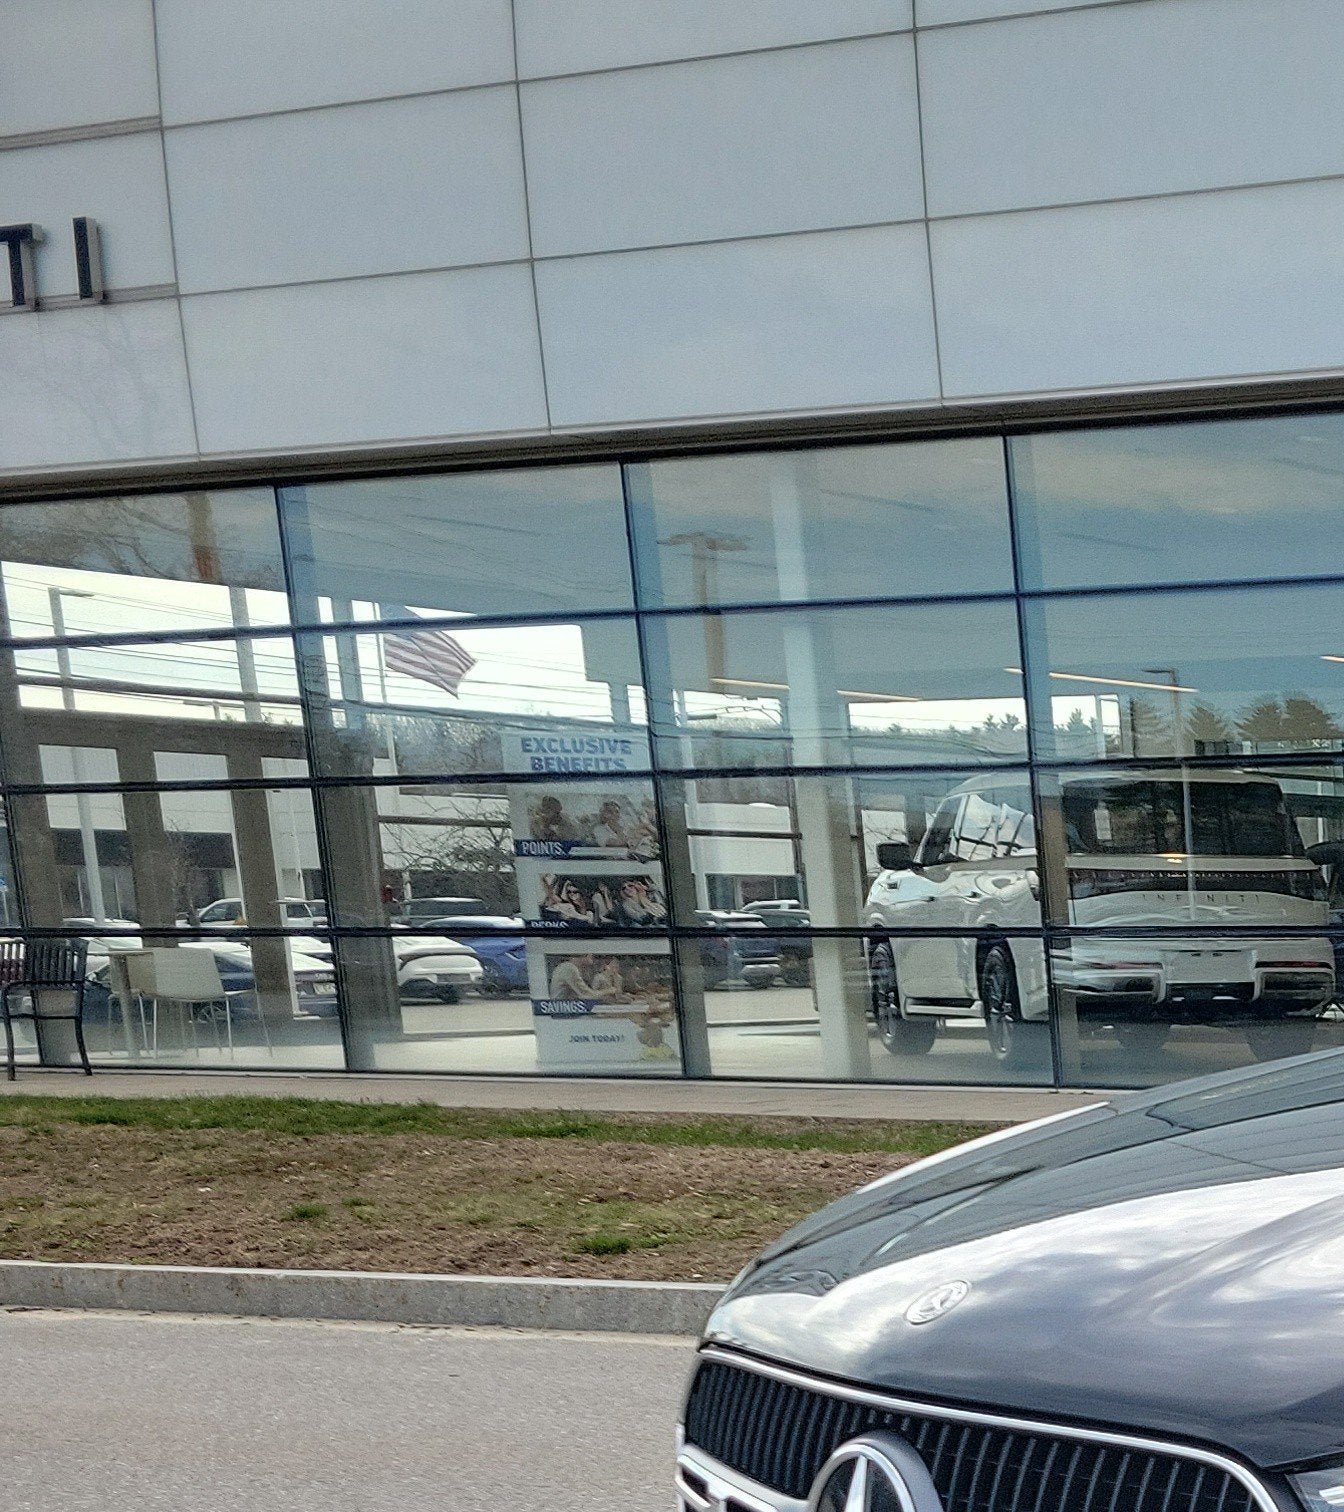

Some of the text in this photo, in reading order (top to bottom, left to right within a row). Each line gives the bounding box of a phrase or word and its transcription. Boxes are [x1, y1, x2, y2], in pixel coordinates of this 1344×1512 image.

[520, 737, 632, 755] EXCLUSIVE
[530, 755, 627, 771] BENEFITS
[1142, 893, 1260, 904] INFNITI
[569, 1034, 590, 1043] JOIN
